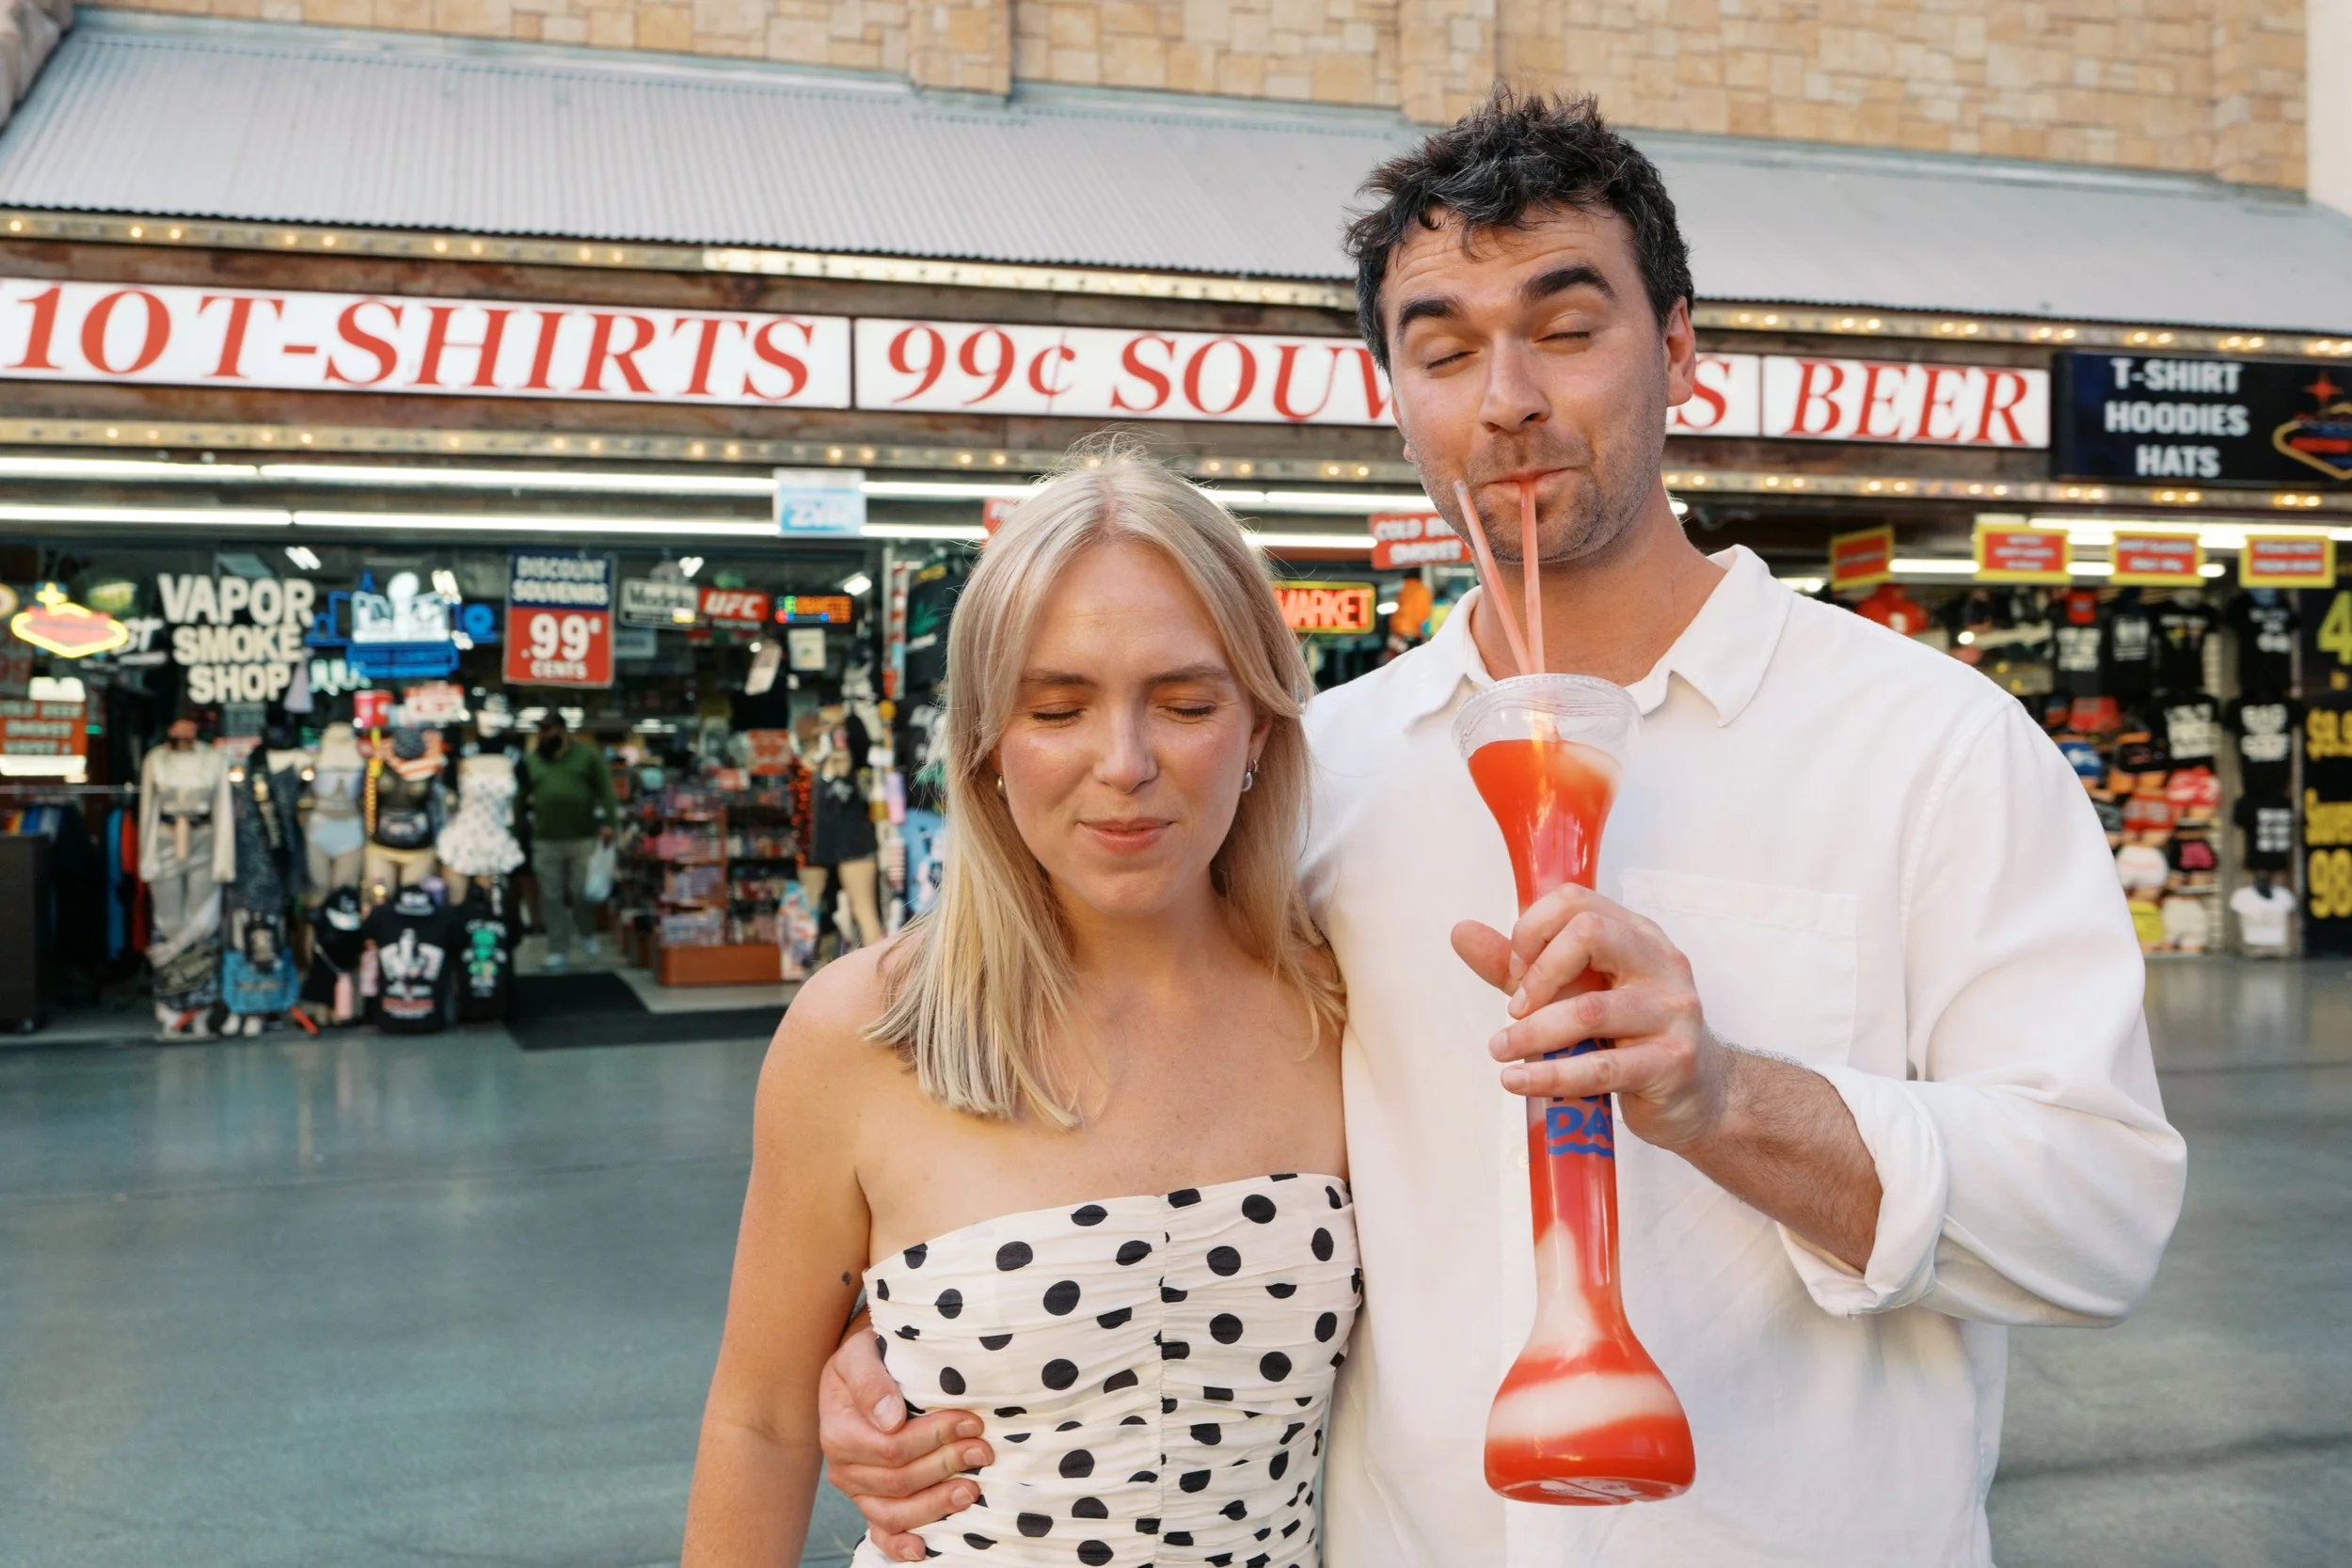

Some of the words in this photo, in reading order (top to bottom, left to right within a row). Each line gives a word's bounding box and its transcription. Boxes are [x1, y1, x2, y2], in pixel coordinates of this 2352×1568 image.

[196, 293, 815, 403] T-SHIRTS
[886, 321, 1076, 414] 99¢
[2109, 356, 2245, 394] T-SHIRT
[1788, 359, 2029, 446] BEER
[2104, 401, 2250, 436] HOODIES
[2135, 444, 2222, 478] HATS
[517, 555, 607, 581] DISCOUNT
[156, 572, 315, 628] VAPOR
[513, 578, 609, 605] SOUVENIRS
[705, 592, 763, 619] UFC
[1273, 589, 1375, 629] MARKET
[172, 624, 303, 666] SMOKE
[186, 662, 291, 705] SHOP
[1545, 1105, 1613, 1142] DA
